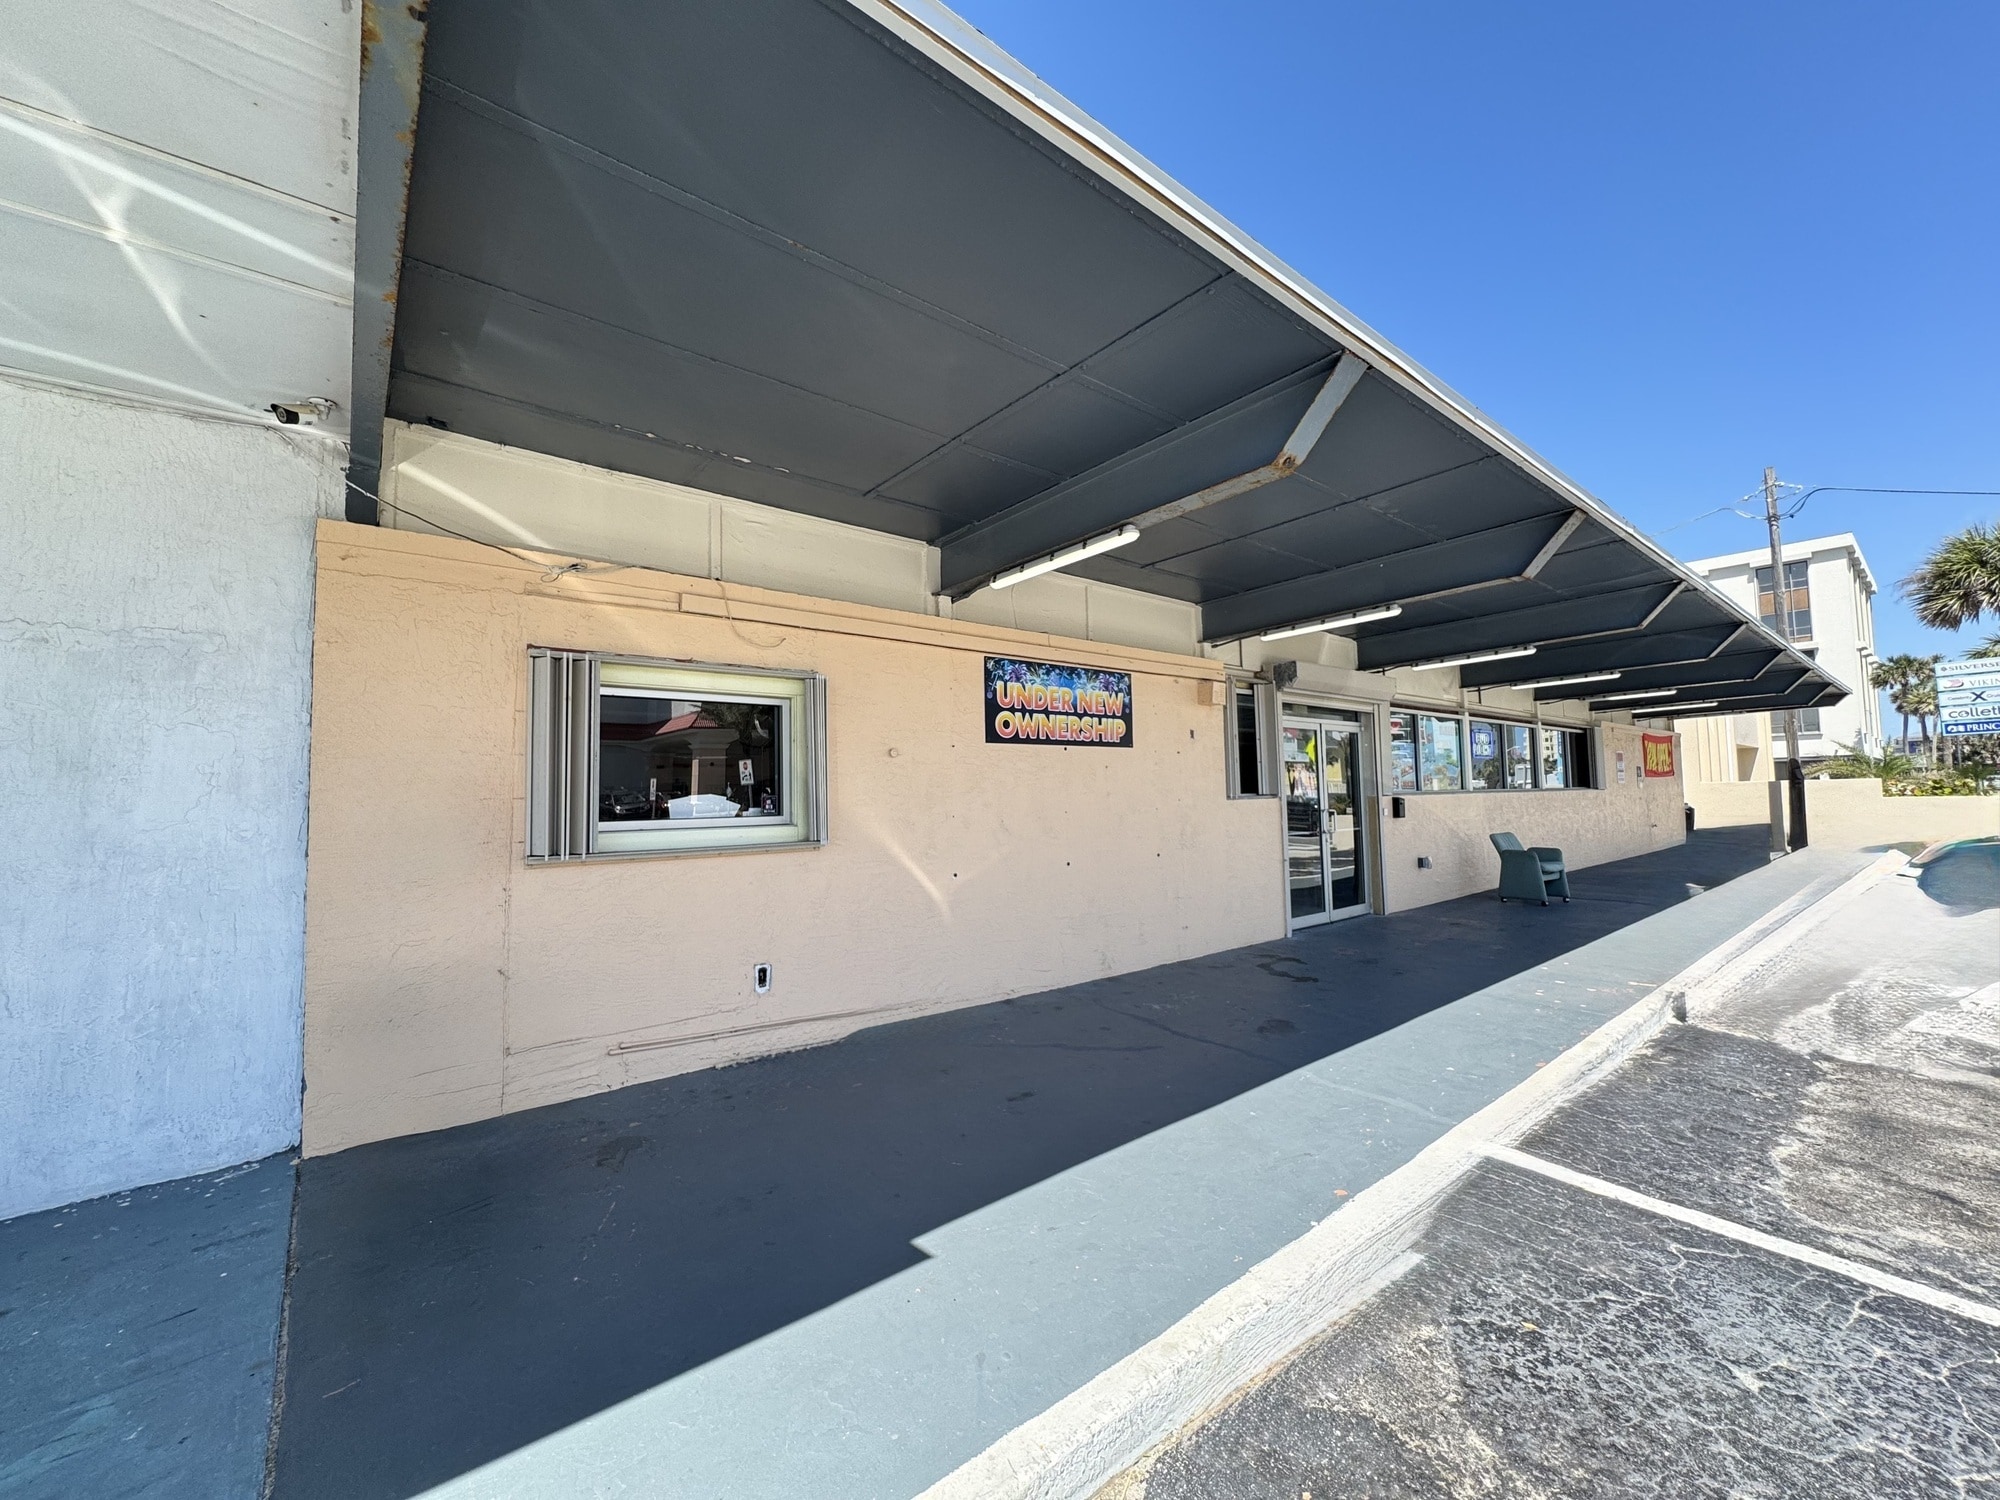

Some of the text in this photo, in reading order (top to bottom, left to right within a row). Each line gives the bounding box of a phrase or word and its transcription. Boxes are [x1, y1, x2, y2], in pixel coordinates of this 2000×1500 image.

[996, 681, 1124, 717] UNDER NEW
[995, 711, 1126, 742] OWNERSHIP
